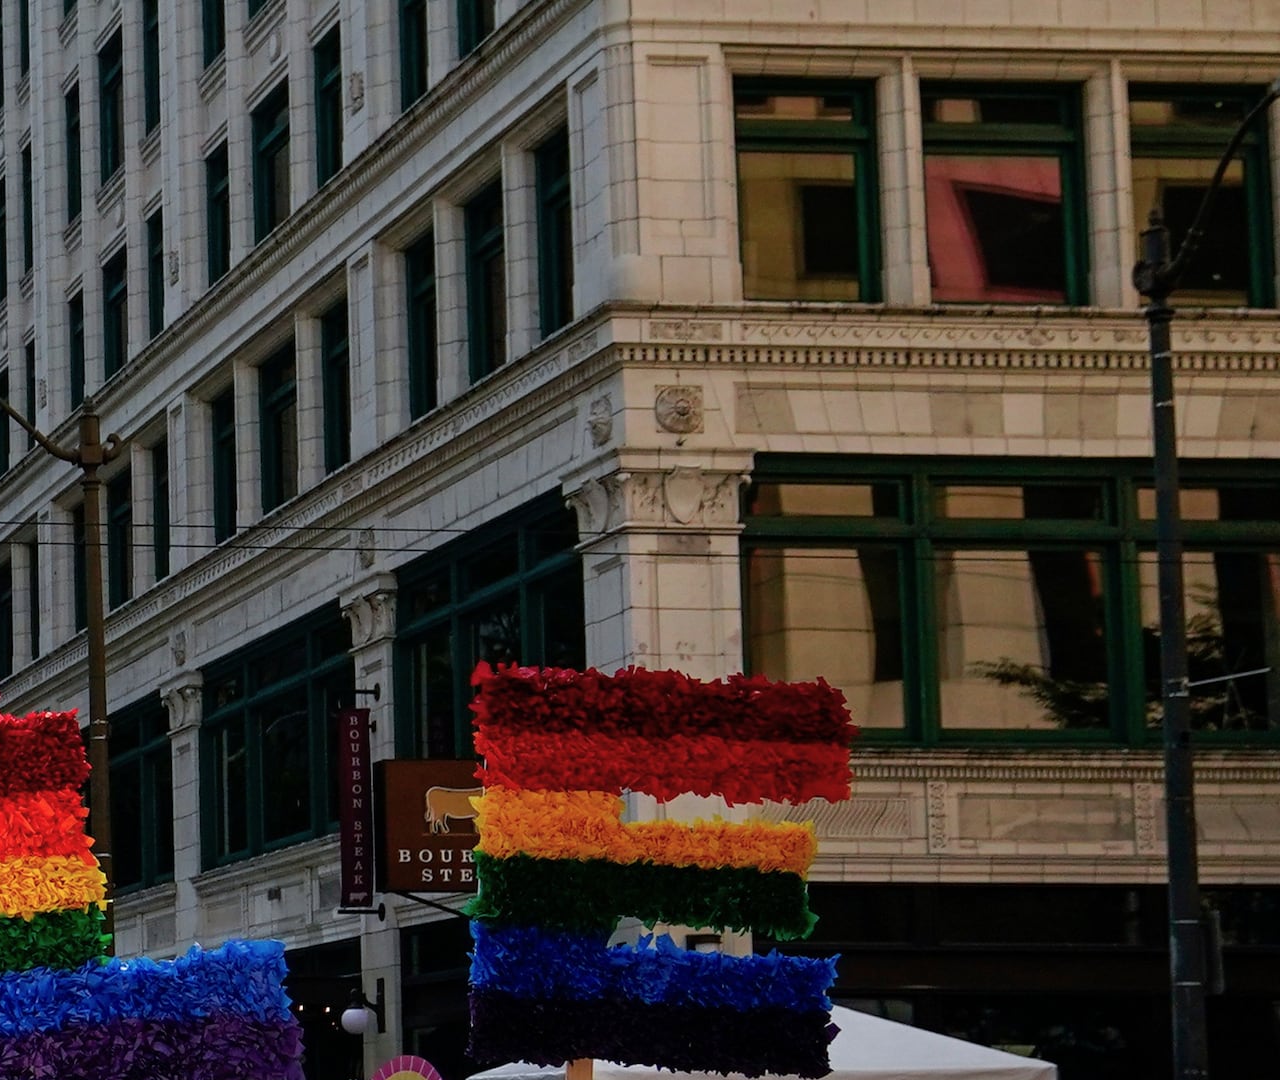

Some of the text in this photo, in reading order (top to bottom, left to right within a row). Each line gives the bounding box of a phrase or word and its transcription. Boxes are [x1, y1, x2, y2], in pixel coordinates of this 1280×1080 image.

[349, 715, 364, 885] BOURBON STEAK
[398, 848, 475, 863] BOUR
[421, 868, 473, 882] STE
